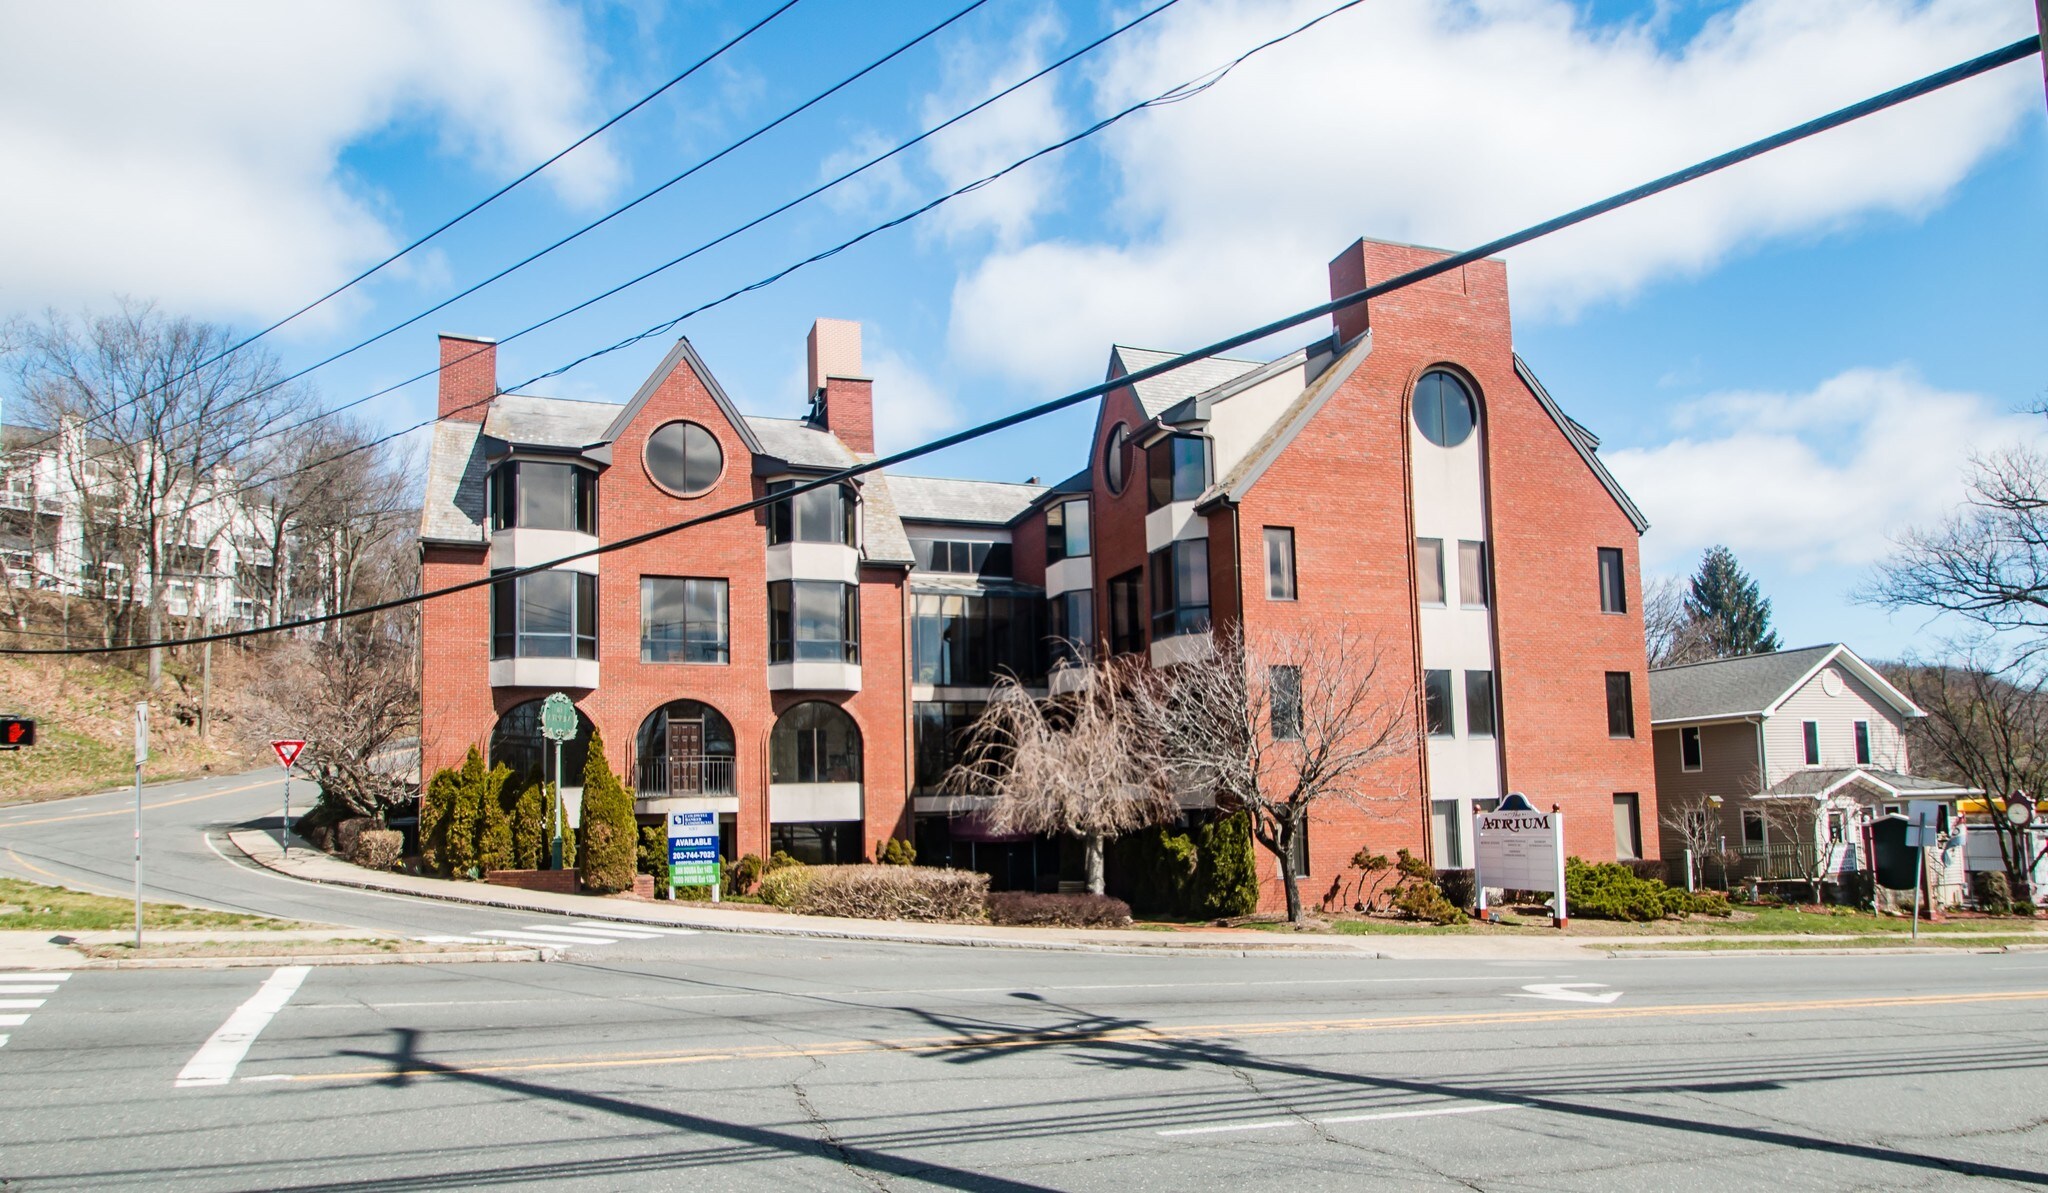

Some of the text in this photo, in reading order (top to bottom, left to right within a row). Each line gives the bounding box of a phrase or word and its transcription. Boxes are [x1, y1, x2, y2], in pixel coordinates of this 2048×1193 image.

[1482, 815, 1550, 832] ATRIUM
[675, 838, 712, 847] AVAILABLE
[672, 851, 716, 860] 203-744-7025
